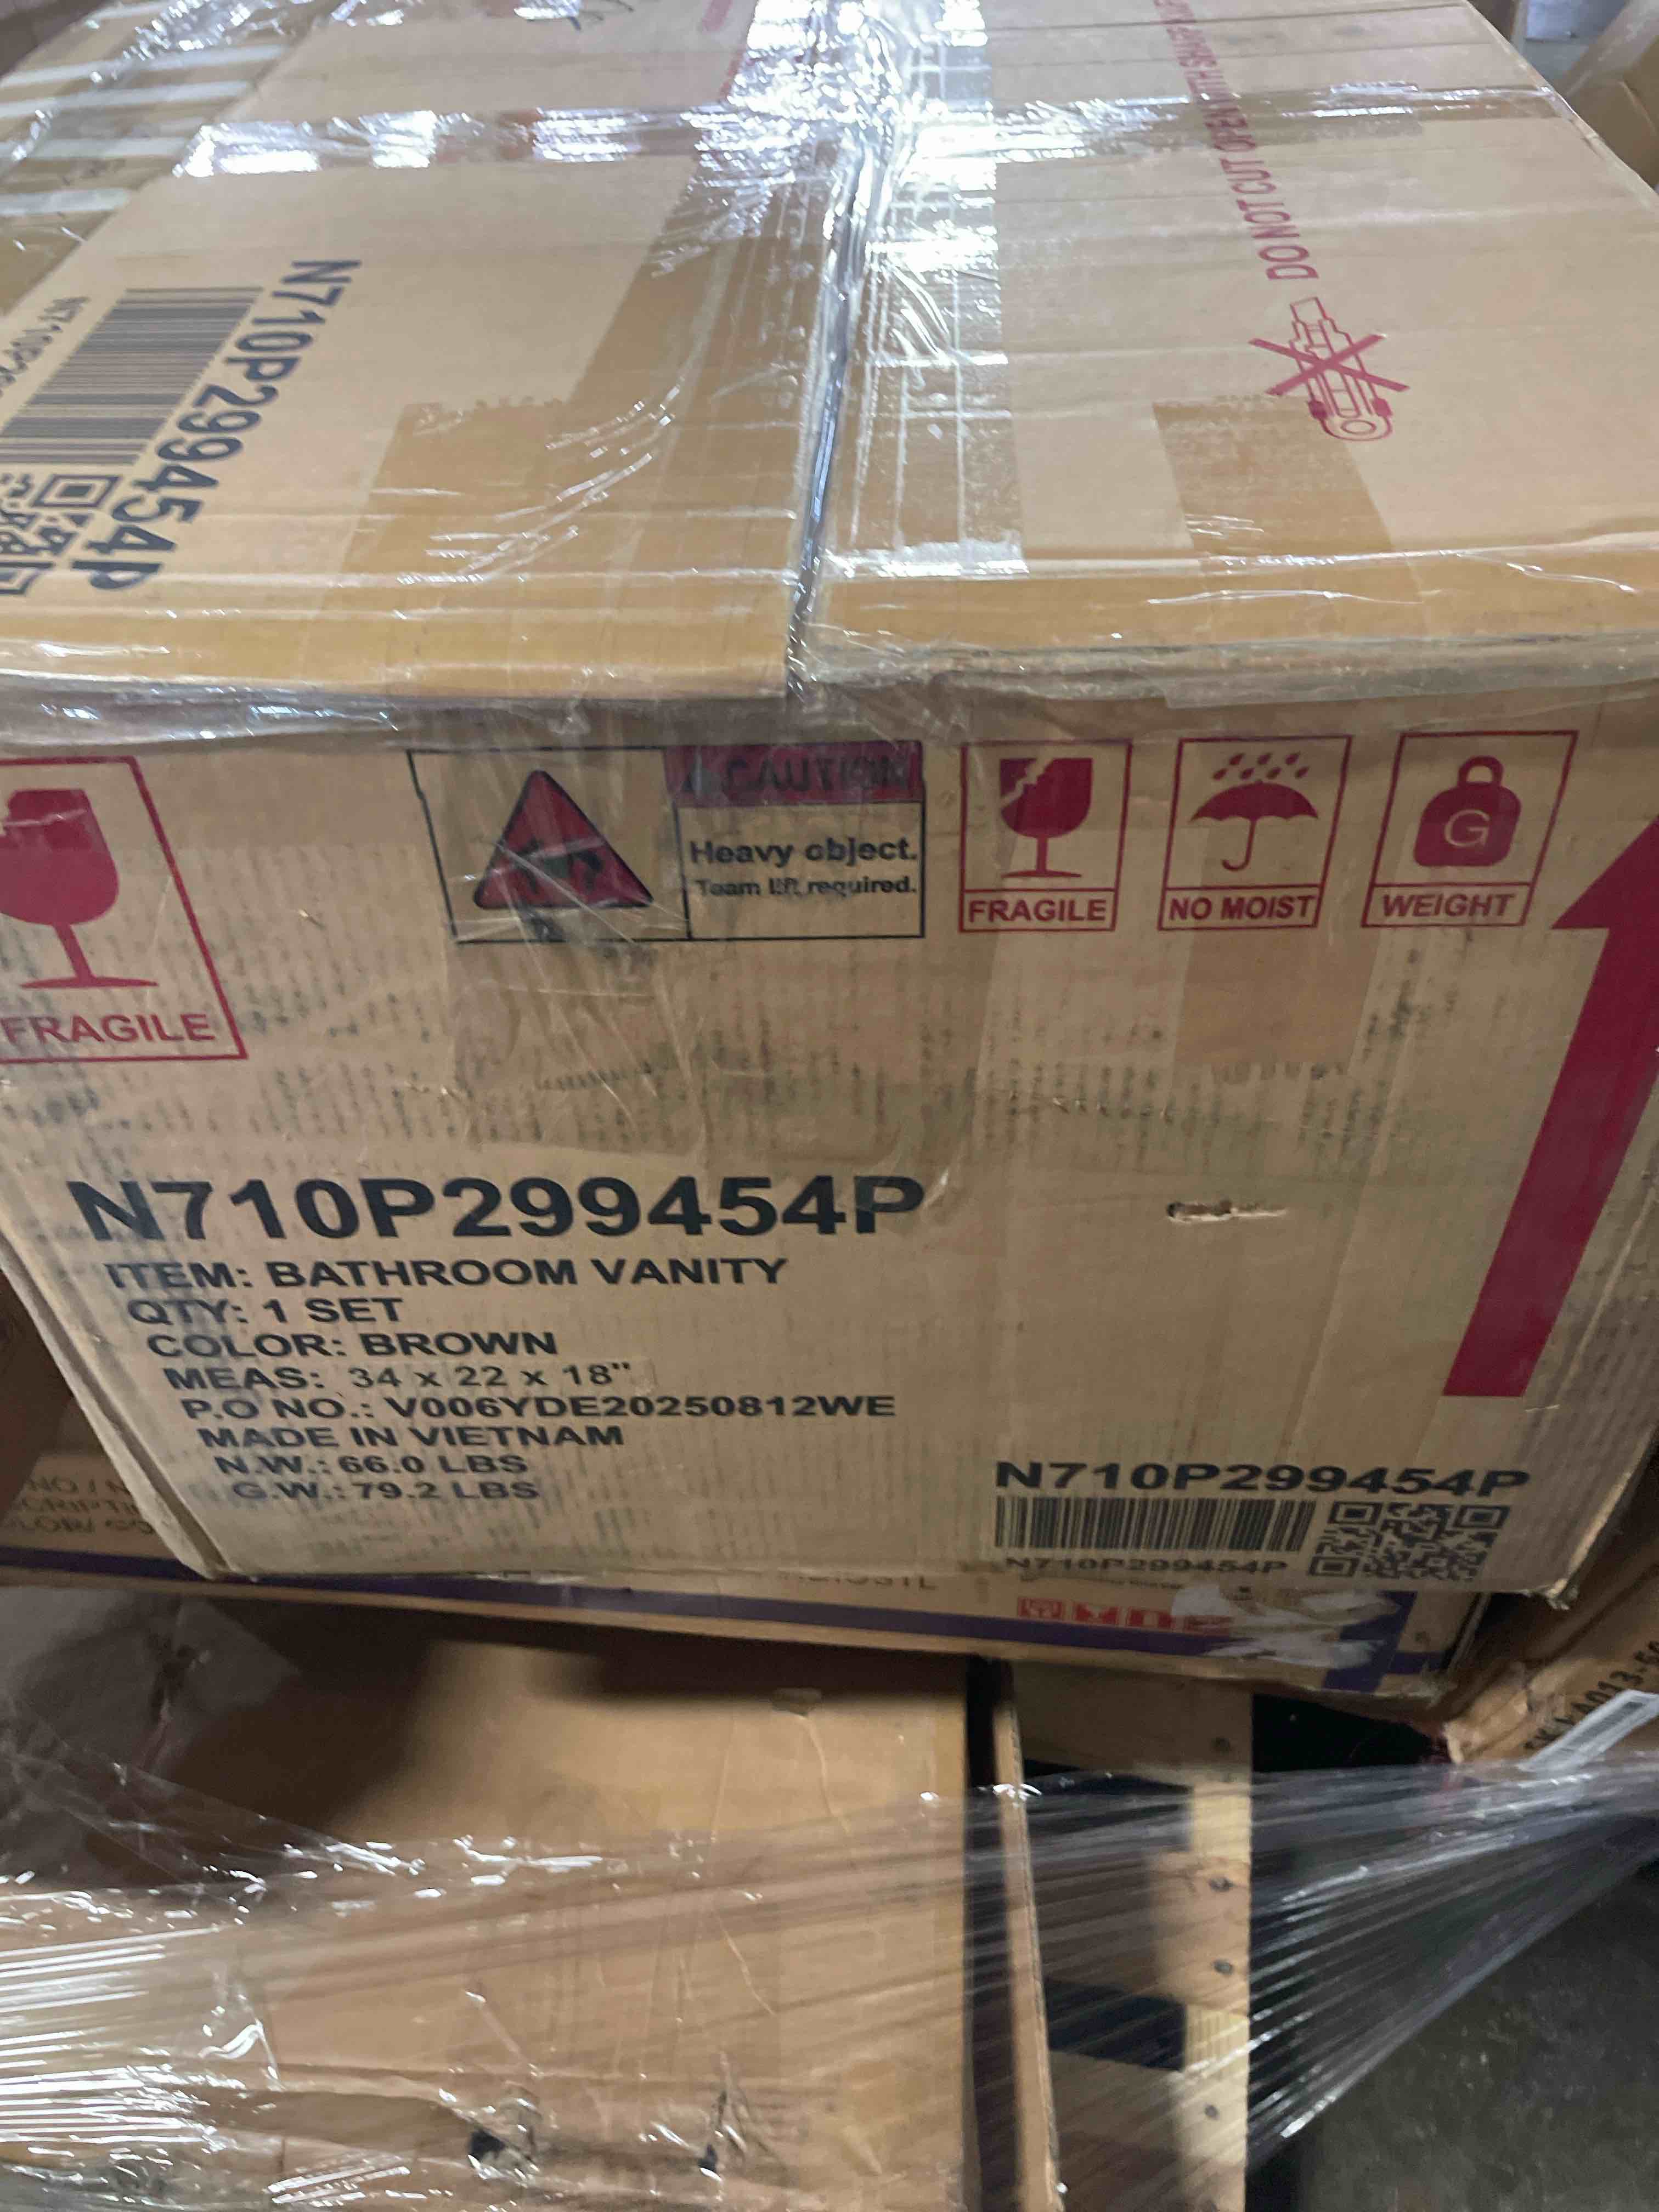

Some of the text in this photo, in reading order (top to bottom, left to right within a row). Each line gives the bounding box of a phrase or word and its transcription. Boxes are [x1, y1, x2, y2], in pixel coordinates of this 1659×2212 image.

[1200, 107, 1256, 152] OPEN
[1218, 159, 1276, 195] CUT
[1237, 199, 1301, 239] NOT
[1258, 244, 1319, 280] DO
[70, 259, 362, 590] N710P299454P
[722, 753, 911, 793] CAUTION
[690, 837, 918, 867] Heavy object.
[695, 879, 761, 897] Team
[968, 899, 1107, 923] FRAGILE
[1169, 895, 1316, 921] NO MOIST
[1382, 894, 1516, 918] WEIGHT
[0, 1013, 216, 1043] FRAGILE
[66, 1175, 925, 1240] N710P299454P
[104, 1257, 788, 1288] ITEM: BATHROOM VANITY
[127, 1297, 404, 1325] QTY: 1 SET
[147, 1331, 558, 1357] COLOR: BROWN
[162, 1367, 325, 1390] MEAS:
[348, 1365, 403, 1389] 34
[454, 1365, 507, 1387] 22
[180, 1395, 896, 1420] P.O NO.: V006YDE20250812WE
[197, 1425, 625, 1448] MADE IN VIETNAM
[213, 1454, 528, 1476] N.W.: 66.0 LBS
[995, 1460, 1531, 1497] N710P299454P
[232, 1481, 540, 1500] G.W.: 79.2 LBS
[1005, 1557, 1289, 1574] N710P299454P
